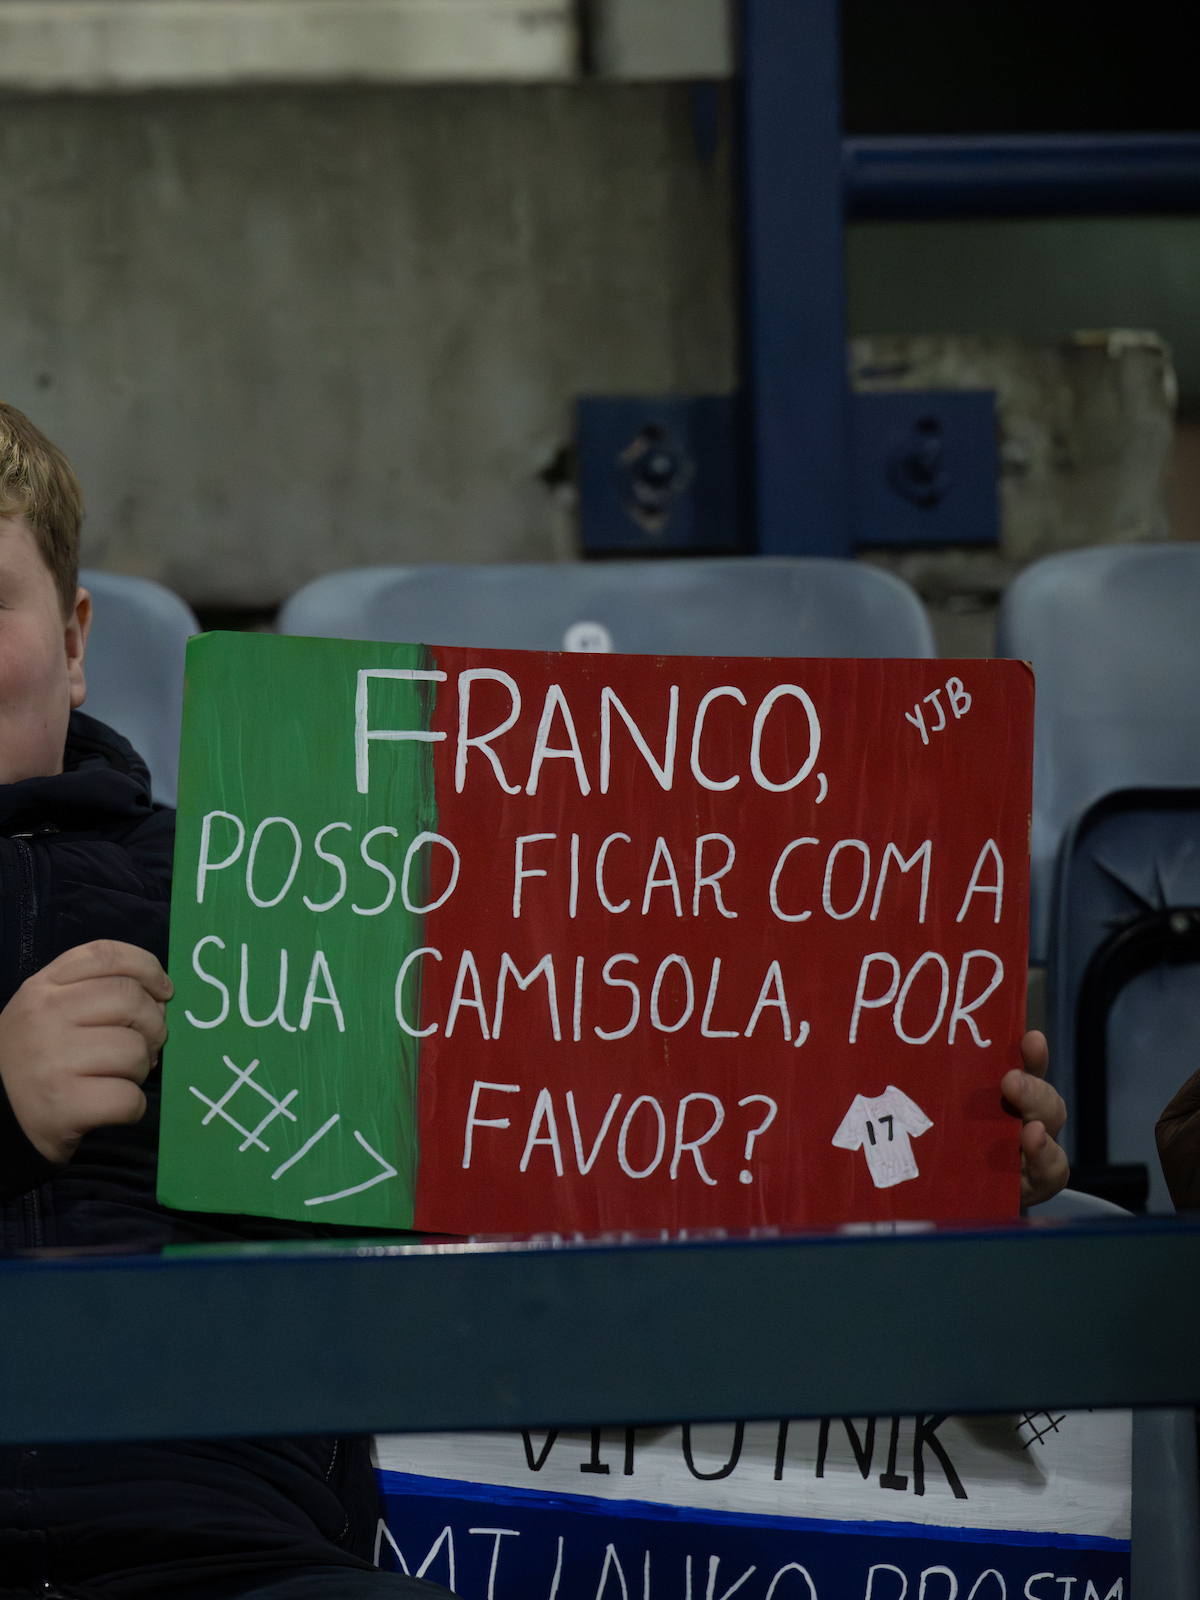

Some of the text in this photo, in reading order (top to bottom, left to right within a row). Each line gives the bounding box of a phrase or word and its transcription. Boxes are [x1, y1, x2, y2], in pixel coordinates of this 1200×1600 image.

[354, 667, 829, 804] FRANCO,
[905, 676, 973, 746] YJB
[196, 810, 1004, 924] POSSO FICAR COM A
[184, 935, 1004, 1048] SUA CAMISOLA, POR
[462, 1080, 778, 1186] FAVOR?
[866, 1114, 893, 1146] 17
